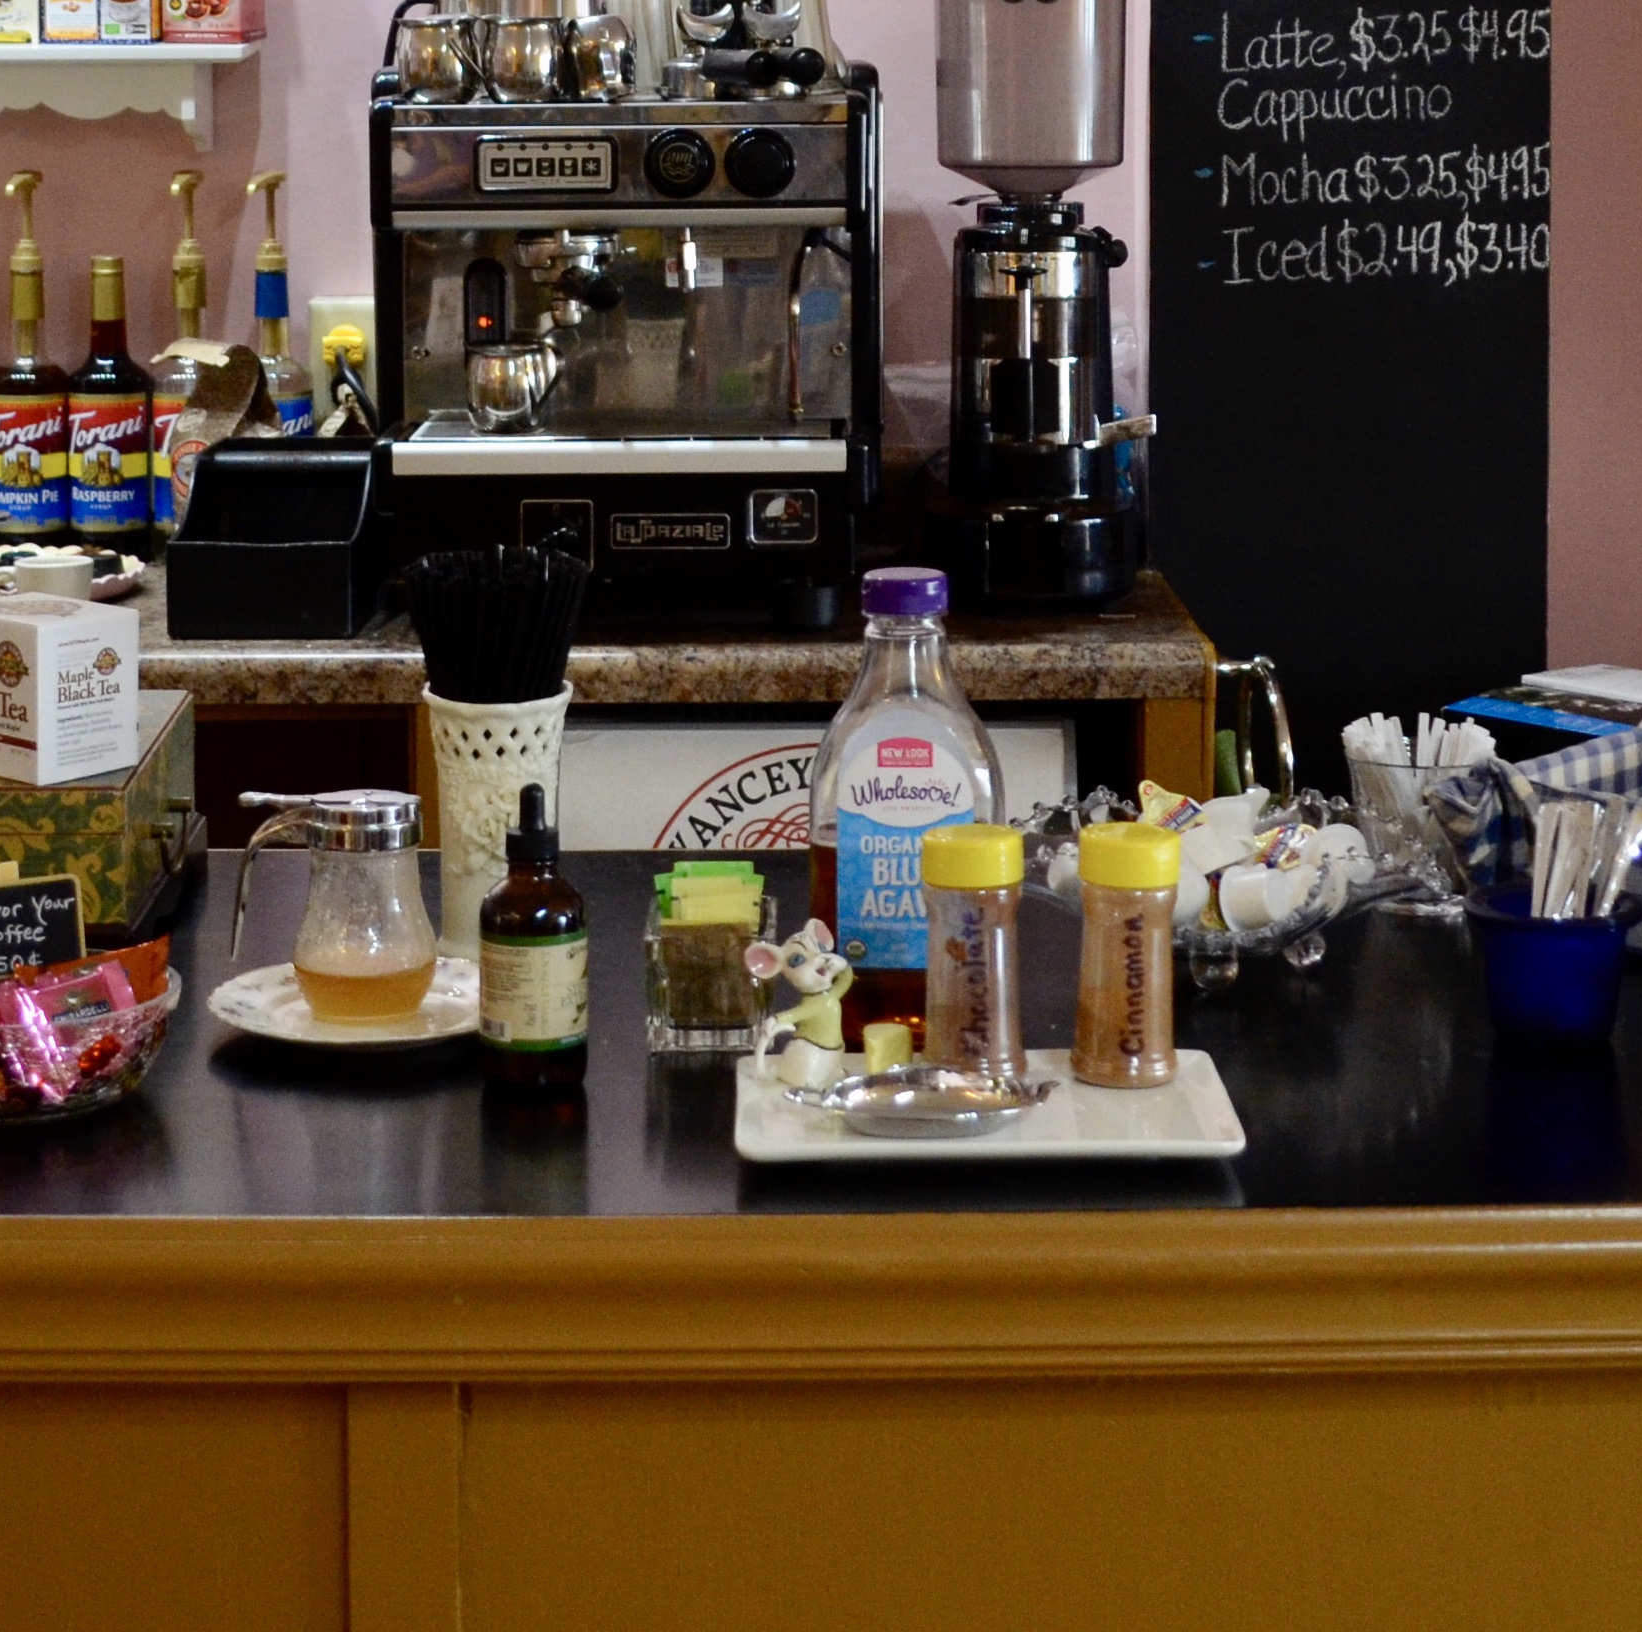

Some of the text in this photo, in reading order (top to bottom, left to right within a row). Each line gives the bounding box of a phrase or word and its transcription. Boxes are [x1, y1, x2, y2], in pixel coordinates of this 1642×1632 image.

[1350, 7, 1452, 72] $3.25
[1459, 5, 1550, 63] $4.95
[1217, 73, 1452, 143] Cappuccino
[1221, 152, 1353, 207] Mocha
[1465, 141, 1550, 204] $4.95
[1222, 225, 1332, 284] Iced
[1457, 212, 1550, 279] $3.40
[68, 405, 143, 457] Torani
[41, 488, 59, 504] PIE
[71, 486, 135, 503] RASPBERRY
[58, 667, 95, 687] Maple
[58, 679, 121, 704] Black Tea
[882, 748, 930, 758] NEW LOOK
[860, 835, 924, 855] ORGA
[873, 857, 923, 887] BLU
[31, 894, 76, 926] Your
[861, 889, 927, 918] AGAV
[1119, 912, 1145, 1056] Cinnamon
